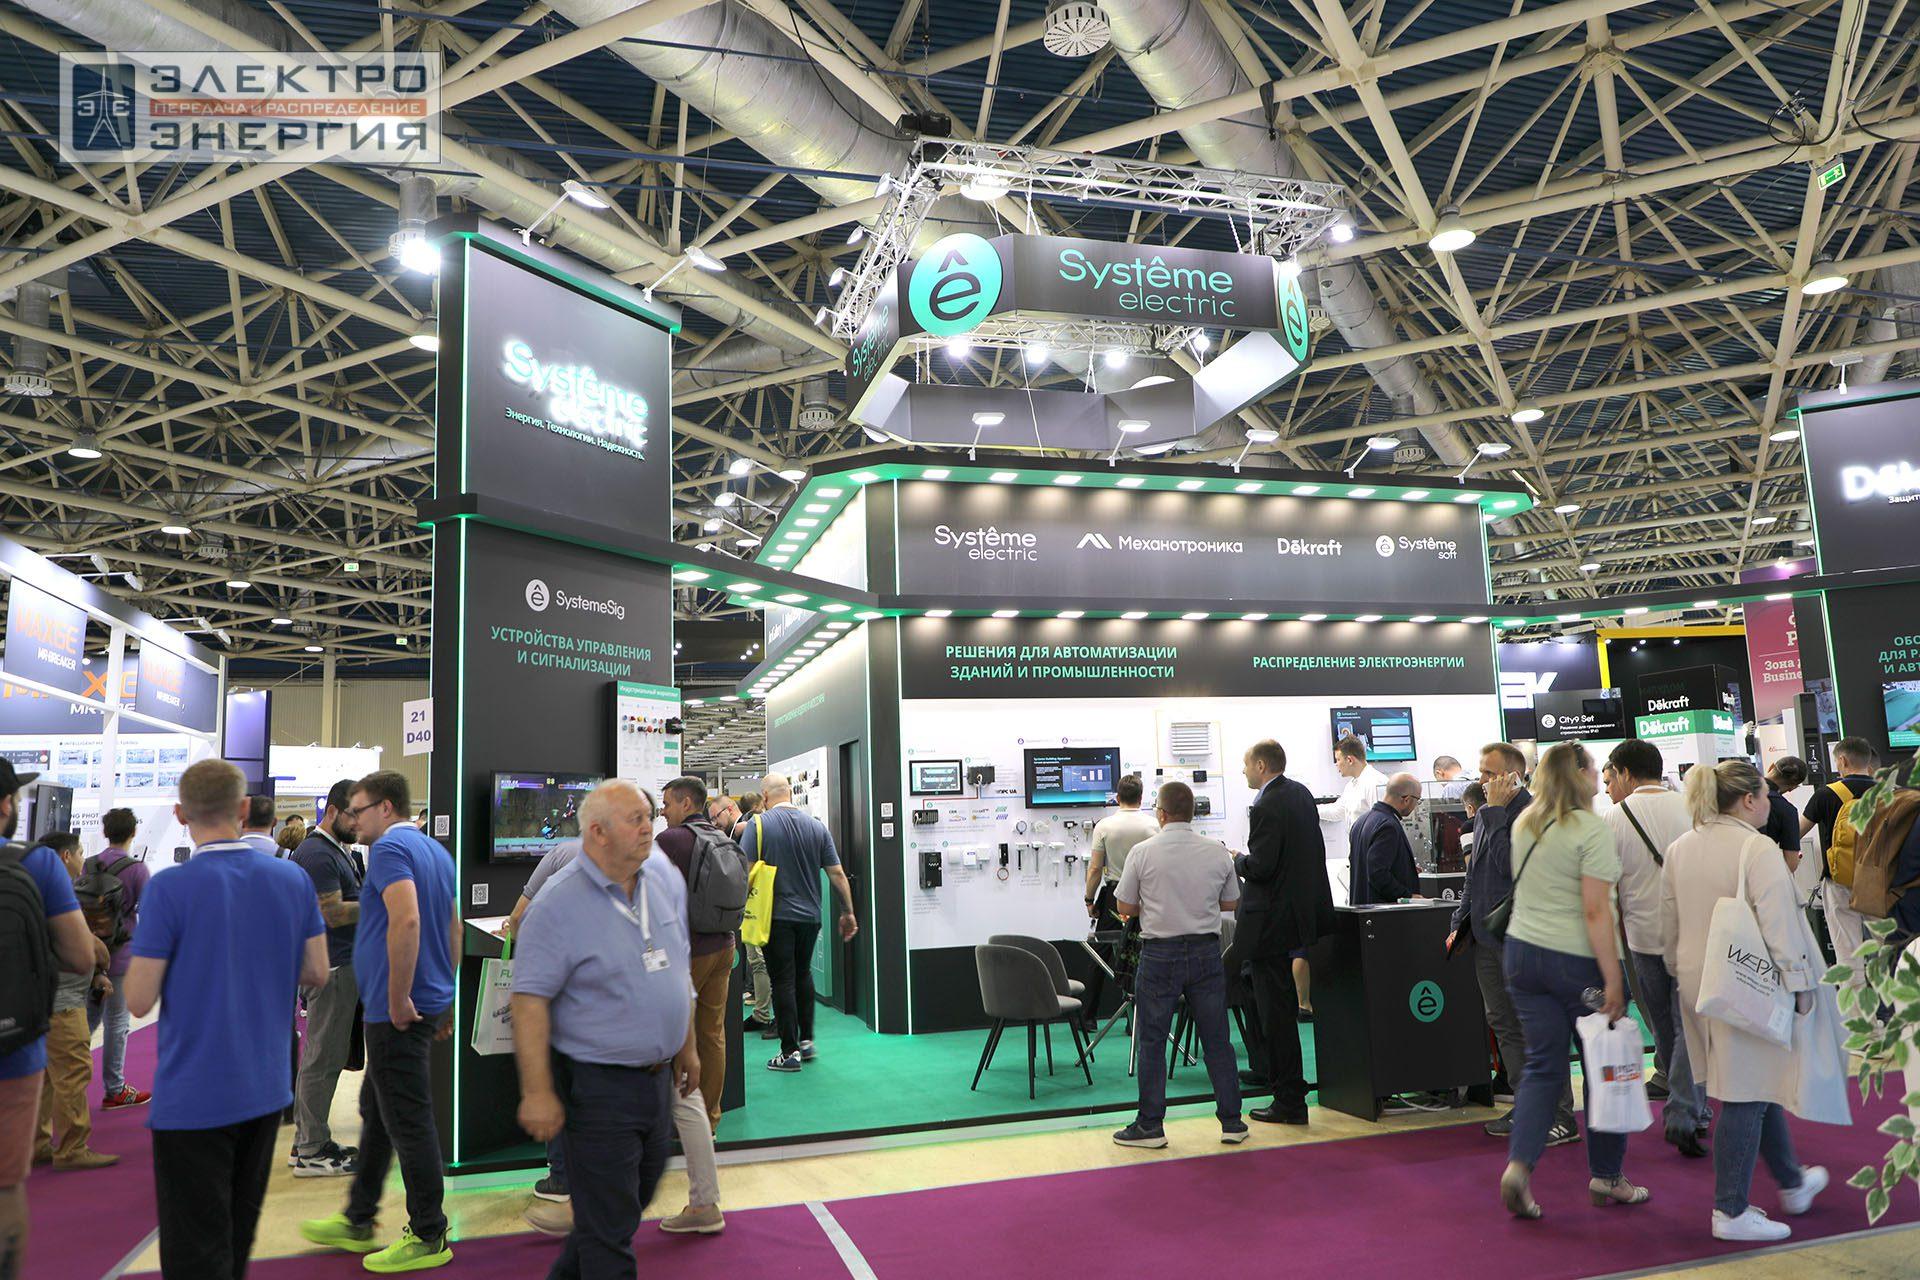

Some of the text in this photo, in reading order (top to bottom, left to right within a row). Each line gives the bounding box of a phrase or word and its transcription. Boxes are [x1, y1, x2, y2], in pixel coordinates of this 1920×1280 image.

[1058, 247, 1234, 294] Systême
[1118, 286, 1236, 317] electric
[934, 525, 1037, 549] Systême
[1118, 535, 1243, 554] Механотроника
[1398, 536, 1457, 552] Systême
[968, 546, 1038, 561] electric
[1277, 537, 1342, 556] Dēkraft
[1437, 548, 1457, 560] soft
[555, 590, 625, 620] SystemeSig
[491, 625, 651, 662] УСТРОЙСТВА УПРАВЛЕНИЯ
[946, 646, 1177, 661] РЕШЕНИЯ ДЛЯ АВТОМАТИЗАЦИИ
[1879, 650, 1907, 663] ДЛЯ
[517, 650, 631, 678] И СИГНАЛИЗАЦИИ
[1253, 656, 1465, 670] РАСПРЕДЕЛЕНИЕ ЭЛЕКТРОЭНЕРГИИ
[1764, 659, 1795, 671] Зона
[1884, 664, 1895, 674] И
[950, 663, 1174, 680] ЗДАНИЙ И ПРОМЫШЛЕННОСТИ
[410, 710, 426, 723] 21
[1581, 714, 1595, 723] Set
[406, 730, 431, 745] D40
